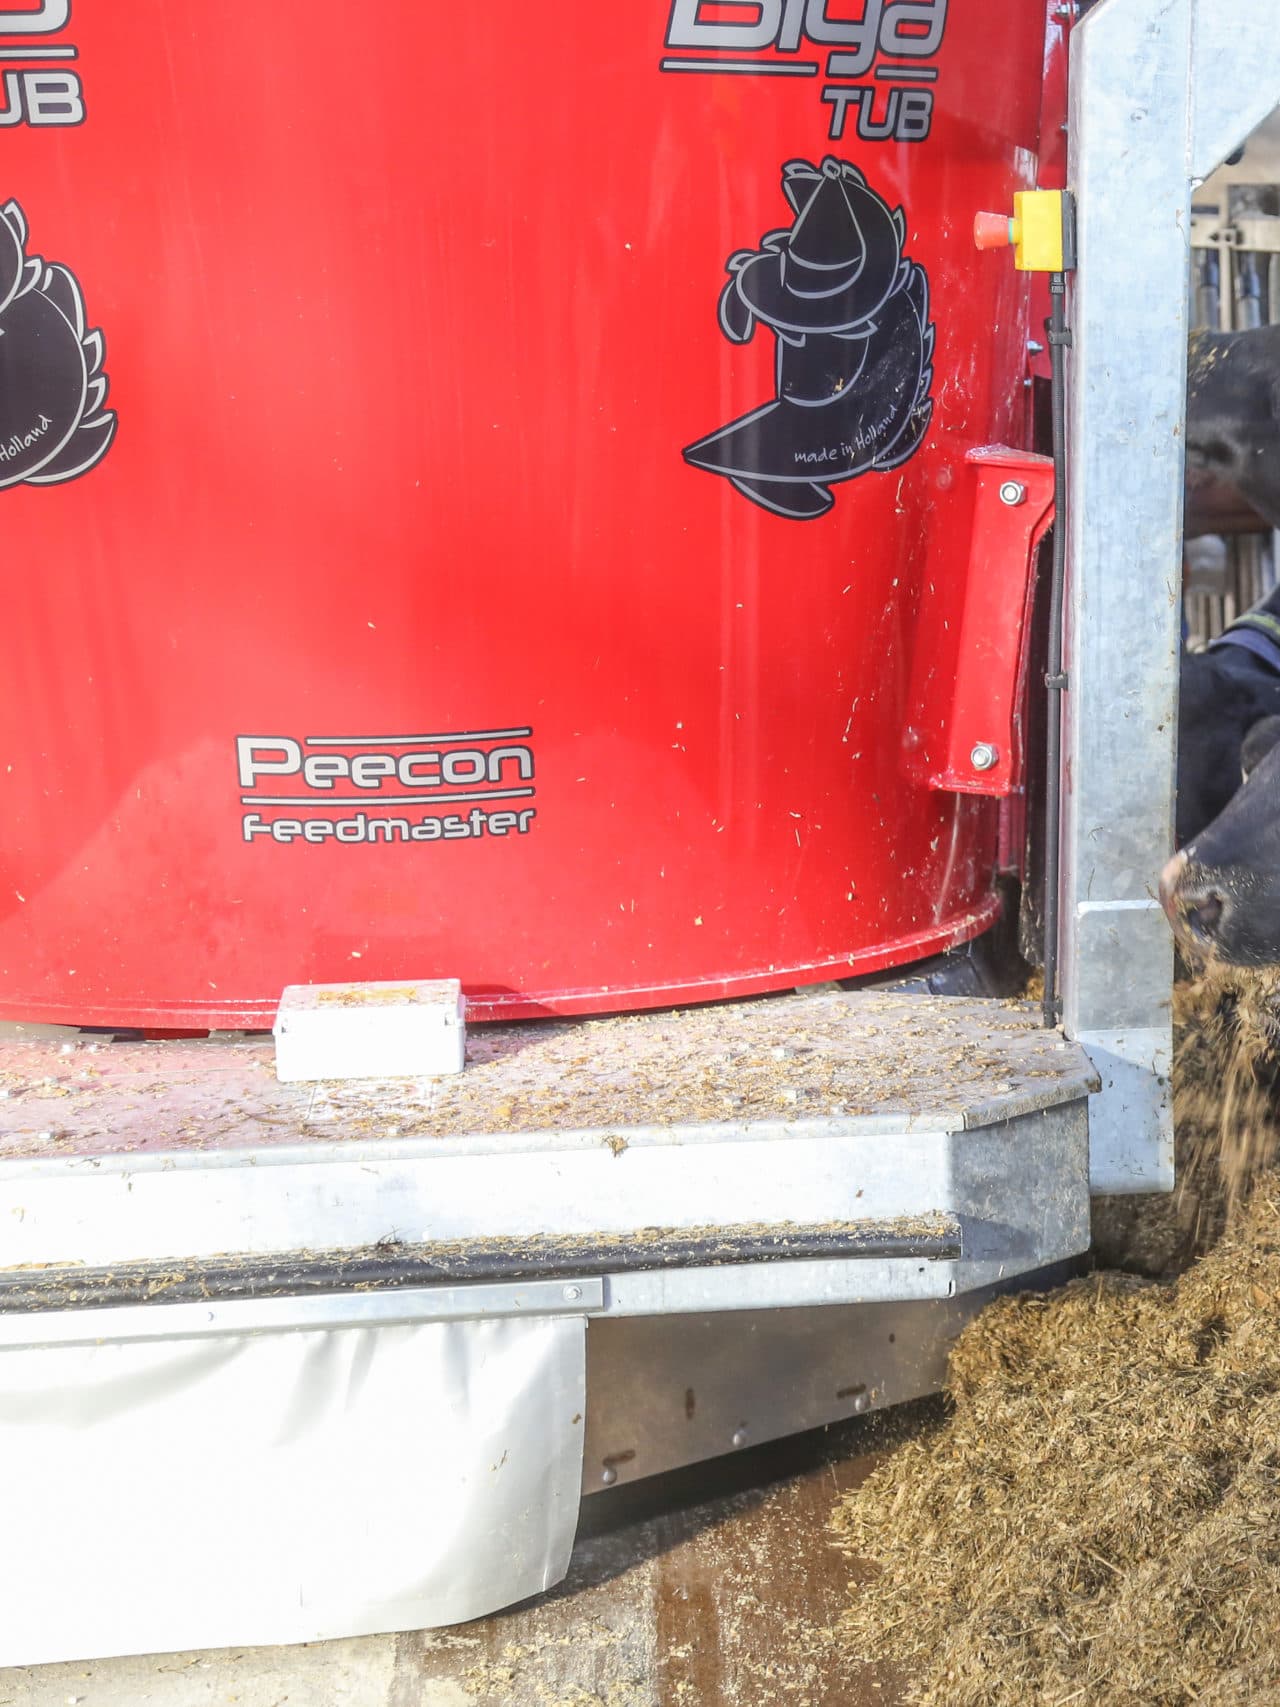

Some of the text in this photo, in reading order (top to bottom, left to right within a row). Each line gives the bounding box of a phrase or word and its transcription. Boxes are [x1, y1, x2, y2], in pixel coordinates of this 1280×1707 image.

[821, 86, 934, 142] TUB
[794, 447, 838, 463] made
[855, 404, 898, 450] Holland
[236, 735, 535, 788] Peecon
